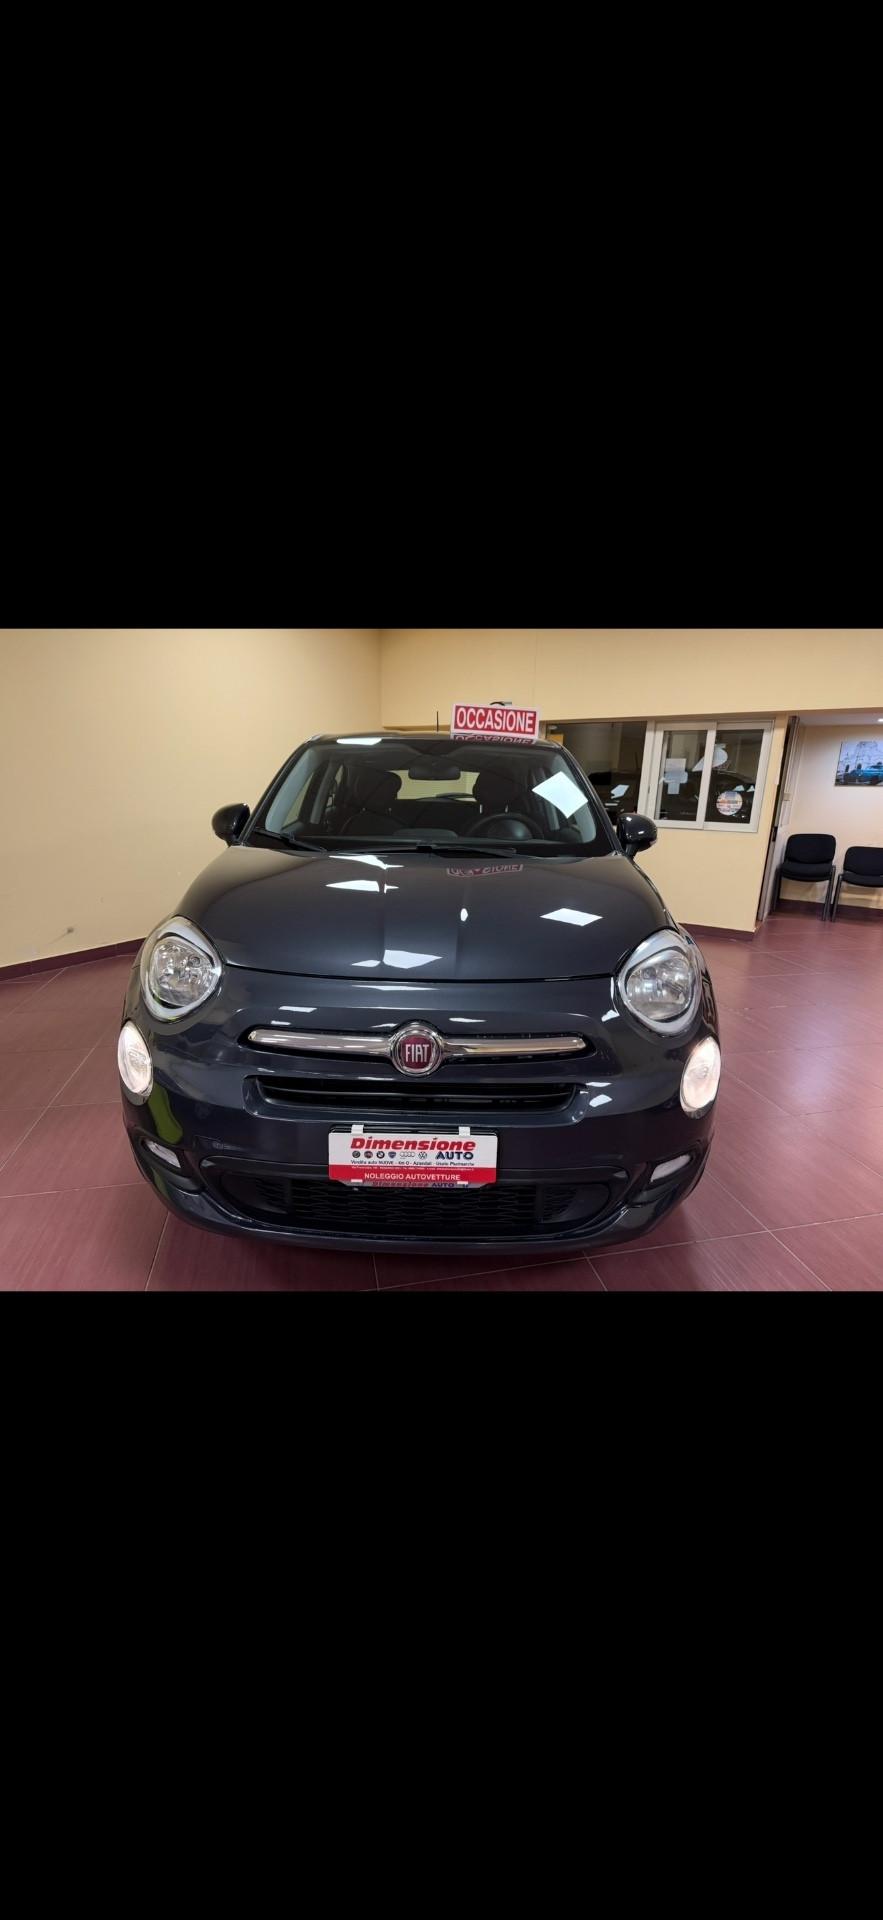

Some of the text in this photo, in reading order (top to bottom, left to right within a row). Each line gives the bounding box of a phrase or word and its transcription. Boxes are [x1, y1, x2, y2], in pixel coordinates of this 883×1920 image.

[456, 707, 534, 732] OCCASIONE
[405, 1044, 429, 1063] FIAT
[350, 1136, 476, 1151] Dimensione
[436, 1151, 474, 1160] AUTO
[364, 1172, 461, 1181] NOLEGGIO AUTOVETTURE
